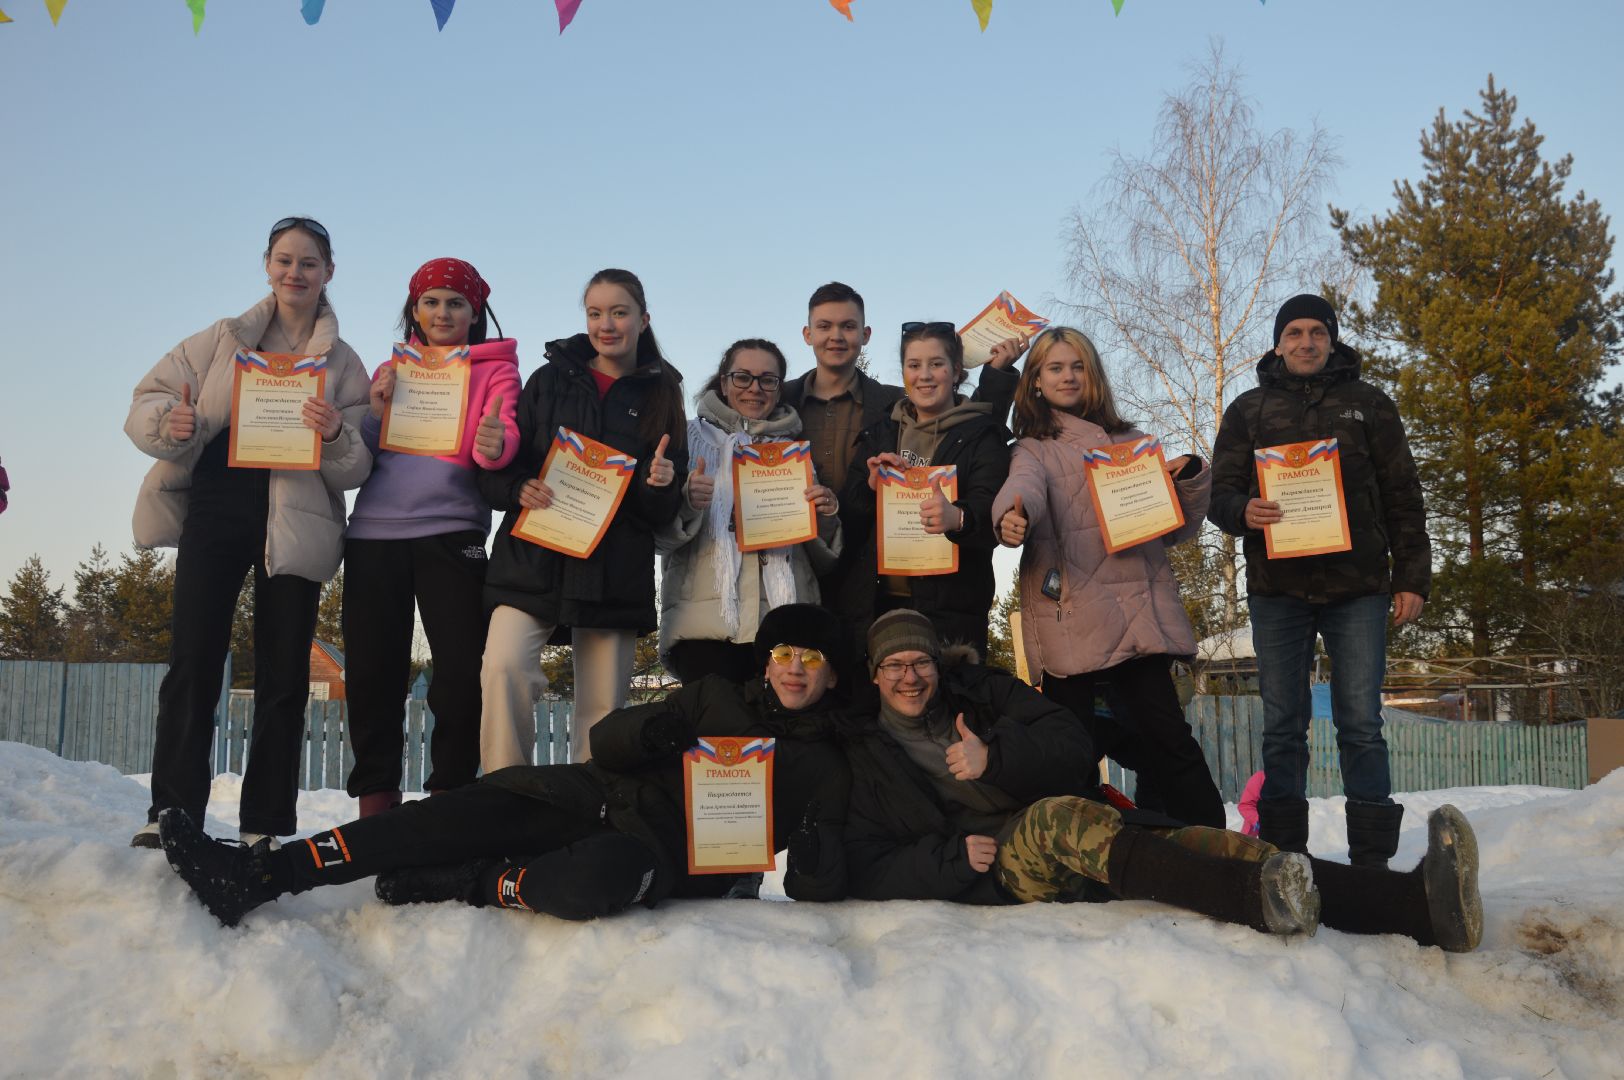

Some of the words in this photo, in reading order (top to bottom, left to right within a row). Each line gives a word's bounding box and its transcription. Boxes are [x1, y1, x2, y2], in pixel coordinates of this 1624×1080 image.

[409, 370, 452, 380] ГРАМОТА
[255, 378, 303, 388] ГРАМОТА
[565, 461, 608, 485] ГРАМОТА
[752, 468, 793, 478] ГРАМОТА
[1105, 463, 1148, 480] ГРАМОТА
[1277, 468, 1320, 481] ГРАМОТА
[896, 491, 934, 500] ГРАМОТ
[706, 769, 751, 778] ГРАМОТА
[707, 791, 752, 799] Награждается
